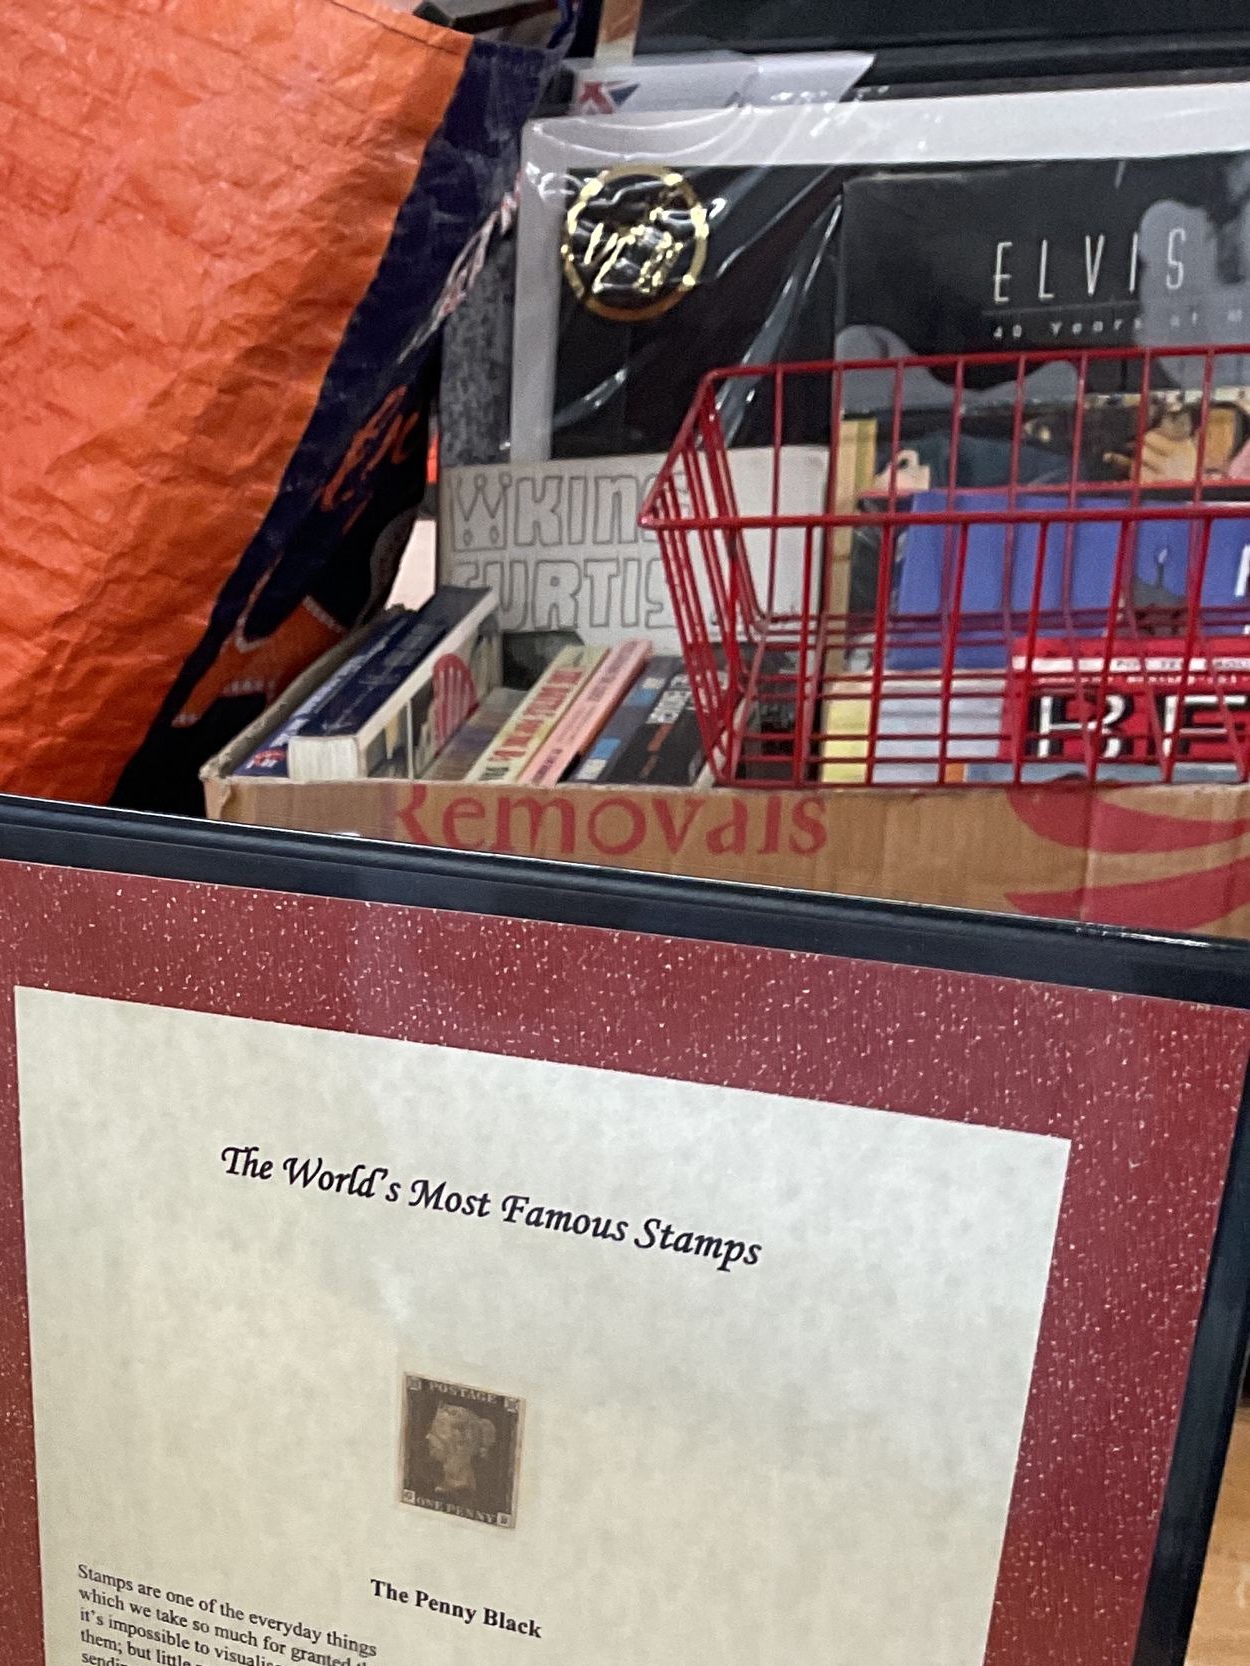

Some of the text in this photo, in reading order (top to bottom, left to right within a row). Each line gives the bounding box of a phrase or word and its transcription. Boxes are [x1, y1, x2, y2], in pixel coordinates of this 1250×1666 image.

[993, 227, 1186, 303] ELVIS
[221, 1146, 762, 1273] The World's Most Famous Stamps
[428, 1381, 498, 1404] POSTAGE
[445, 1503, 497, 1524] PENNY
[77, 1563, 377, 1659] Stamps are one of the everyday things
[370, 1578, 541, 1639] The Penny Black
